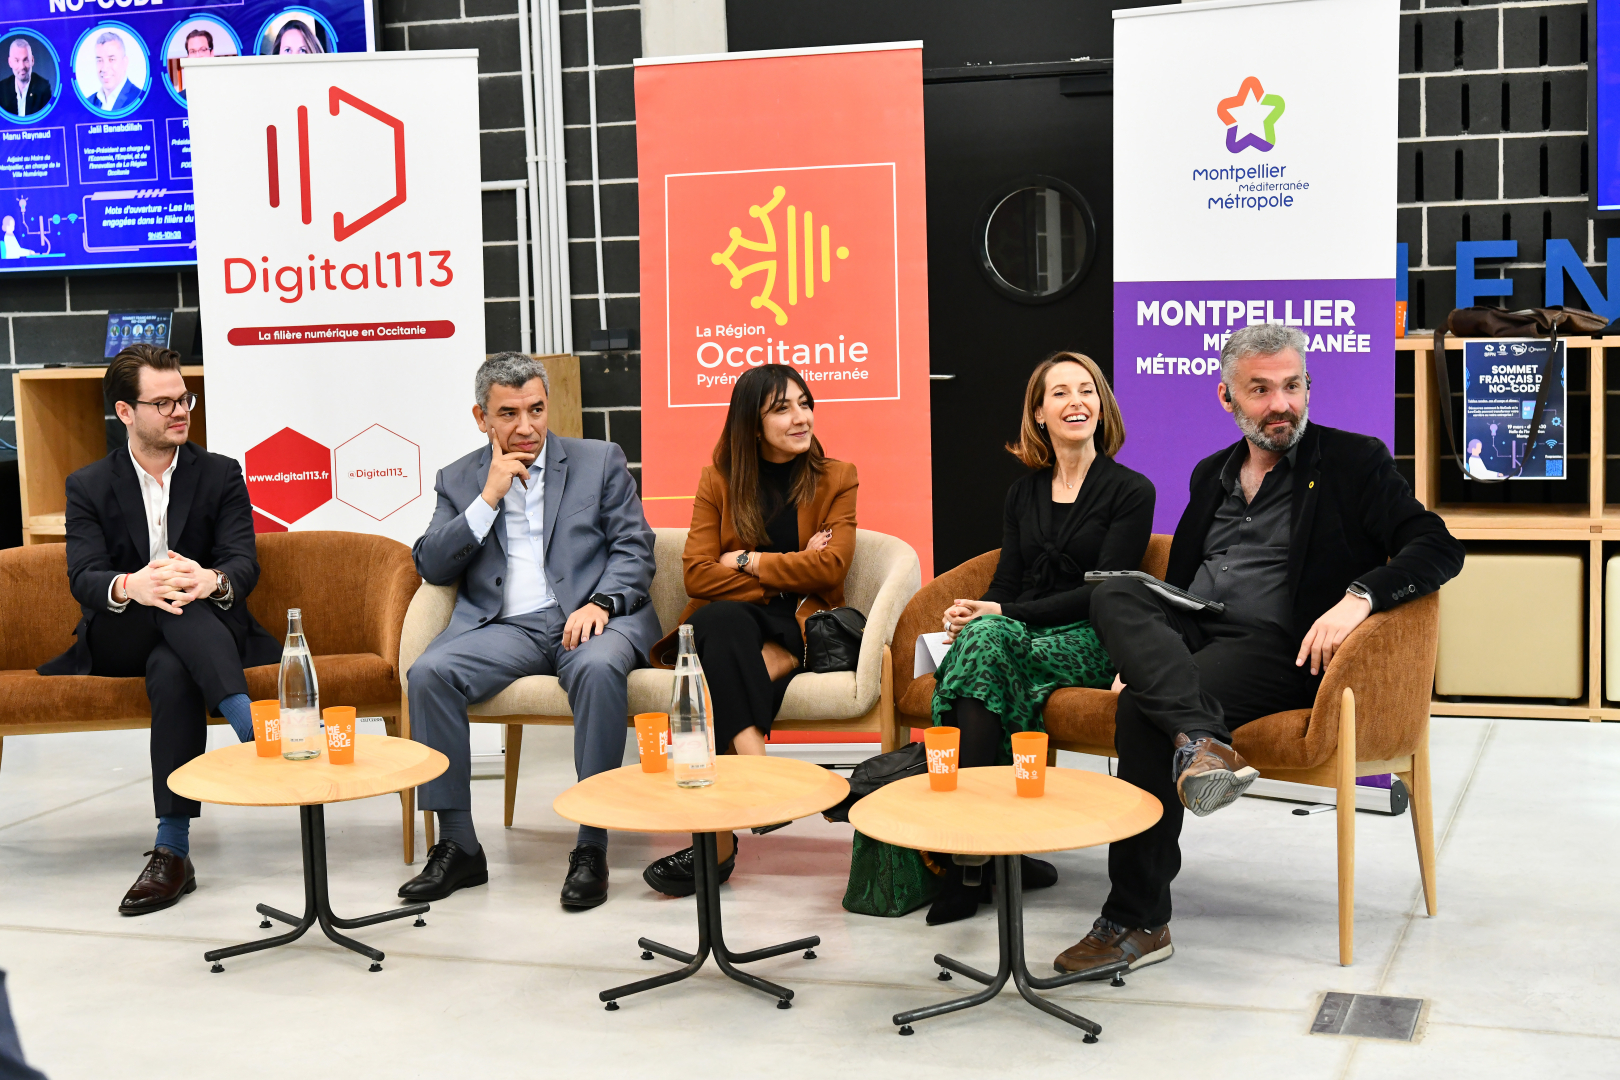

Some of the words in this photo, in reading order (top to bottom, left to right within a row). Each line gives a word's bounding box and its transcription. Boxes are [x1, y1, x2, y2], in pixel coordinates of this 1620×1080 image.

[49, 0, 163, 13] NO-C
[105, 205, 122, 215] Mots
[124, 204, 162, 214] d'ouverture
[168, 203, 182, 212] Les
[102, 216, 136, 228] engagées
[137, 215, 154, 225] dans
[156, 215, 163, 224] la
[184, 214, 194, 223] du
[224, 249, 454, 304] Digital113
[1137, 299, 1357, 327] MONTPELLIER
[258, 331, 271, 341] La
[274, 328, 302, 340] filière
[304, 327, 359, 341] numérique
[361, 327, 375, 337] en
[377, 325, 427, 337] Occitanie
[696, 326, 712, 338] La
[715, 323, 766, 339] Région
[696, 334, 869, 369] Occitanie
[1136, 353, 1222, 376] MÉTROP
[1491, 365, 1539, 374] SOMMET
[697, 373, 741, 388] Pyrén
[798, 367, 869, 383] diterranée
[1479, 375, 1534, 386] FRANÇAIS
[1536, 375, 1543, 383] D
[248, 470, 329, 483] www.digital113.fr
[265, 719, 280, 727] MO
[327, 724, 340, 734] MÉ
[266, 733, 280, 742] LIE
[328, 732, 347, 741] TRO
[329, 738, 351, 748] POLE
[927, 748, 955, 758] MONT
